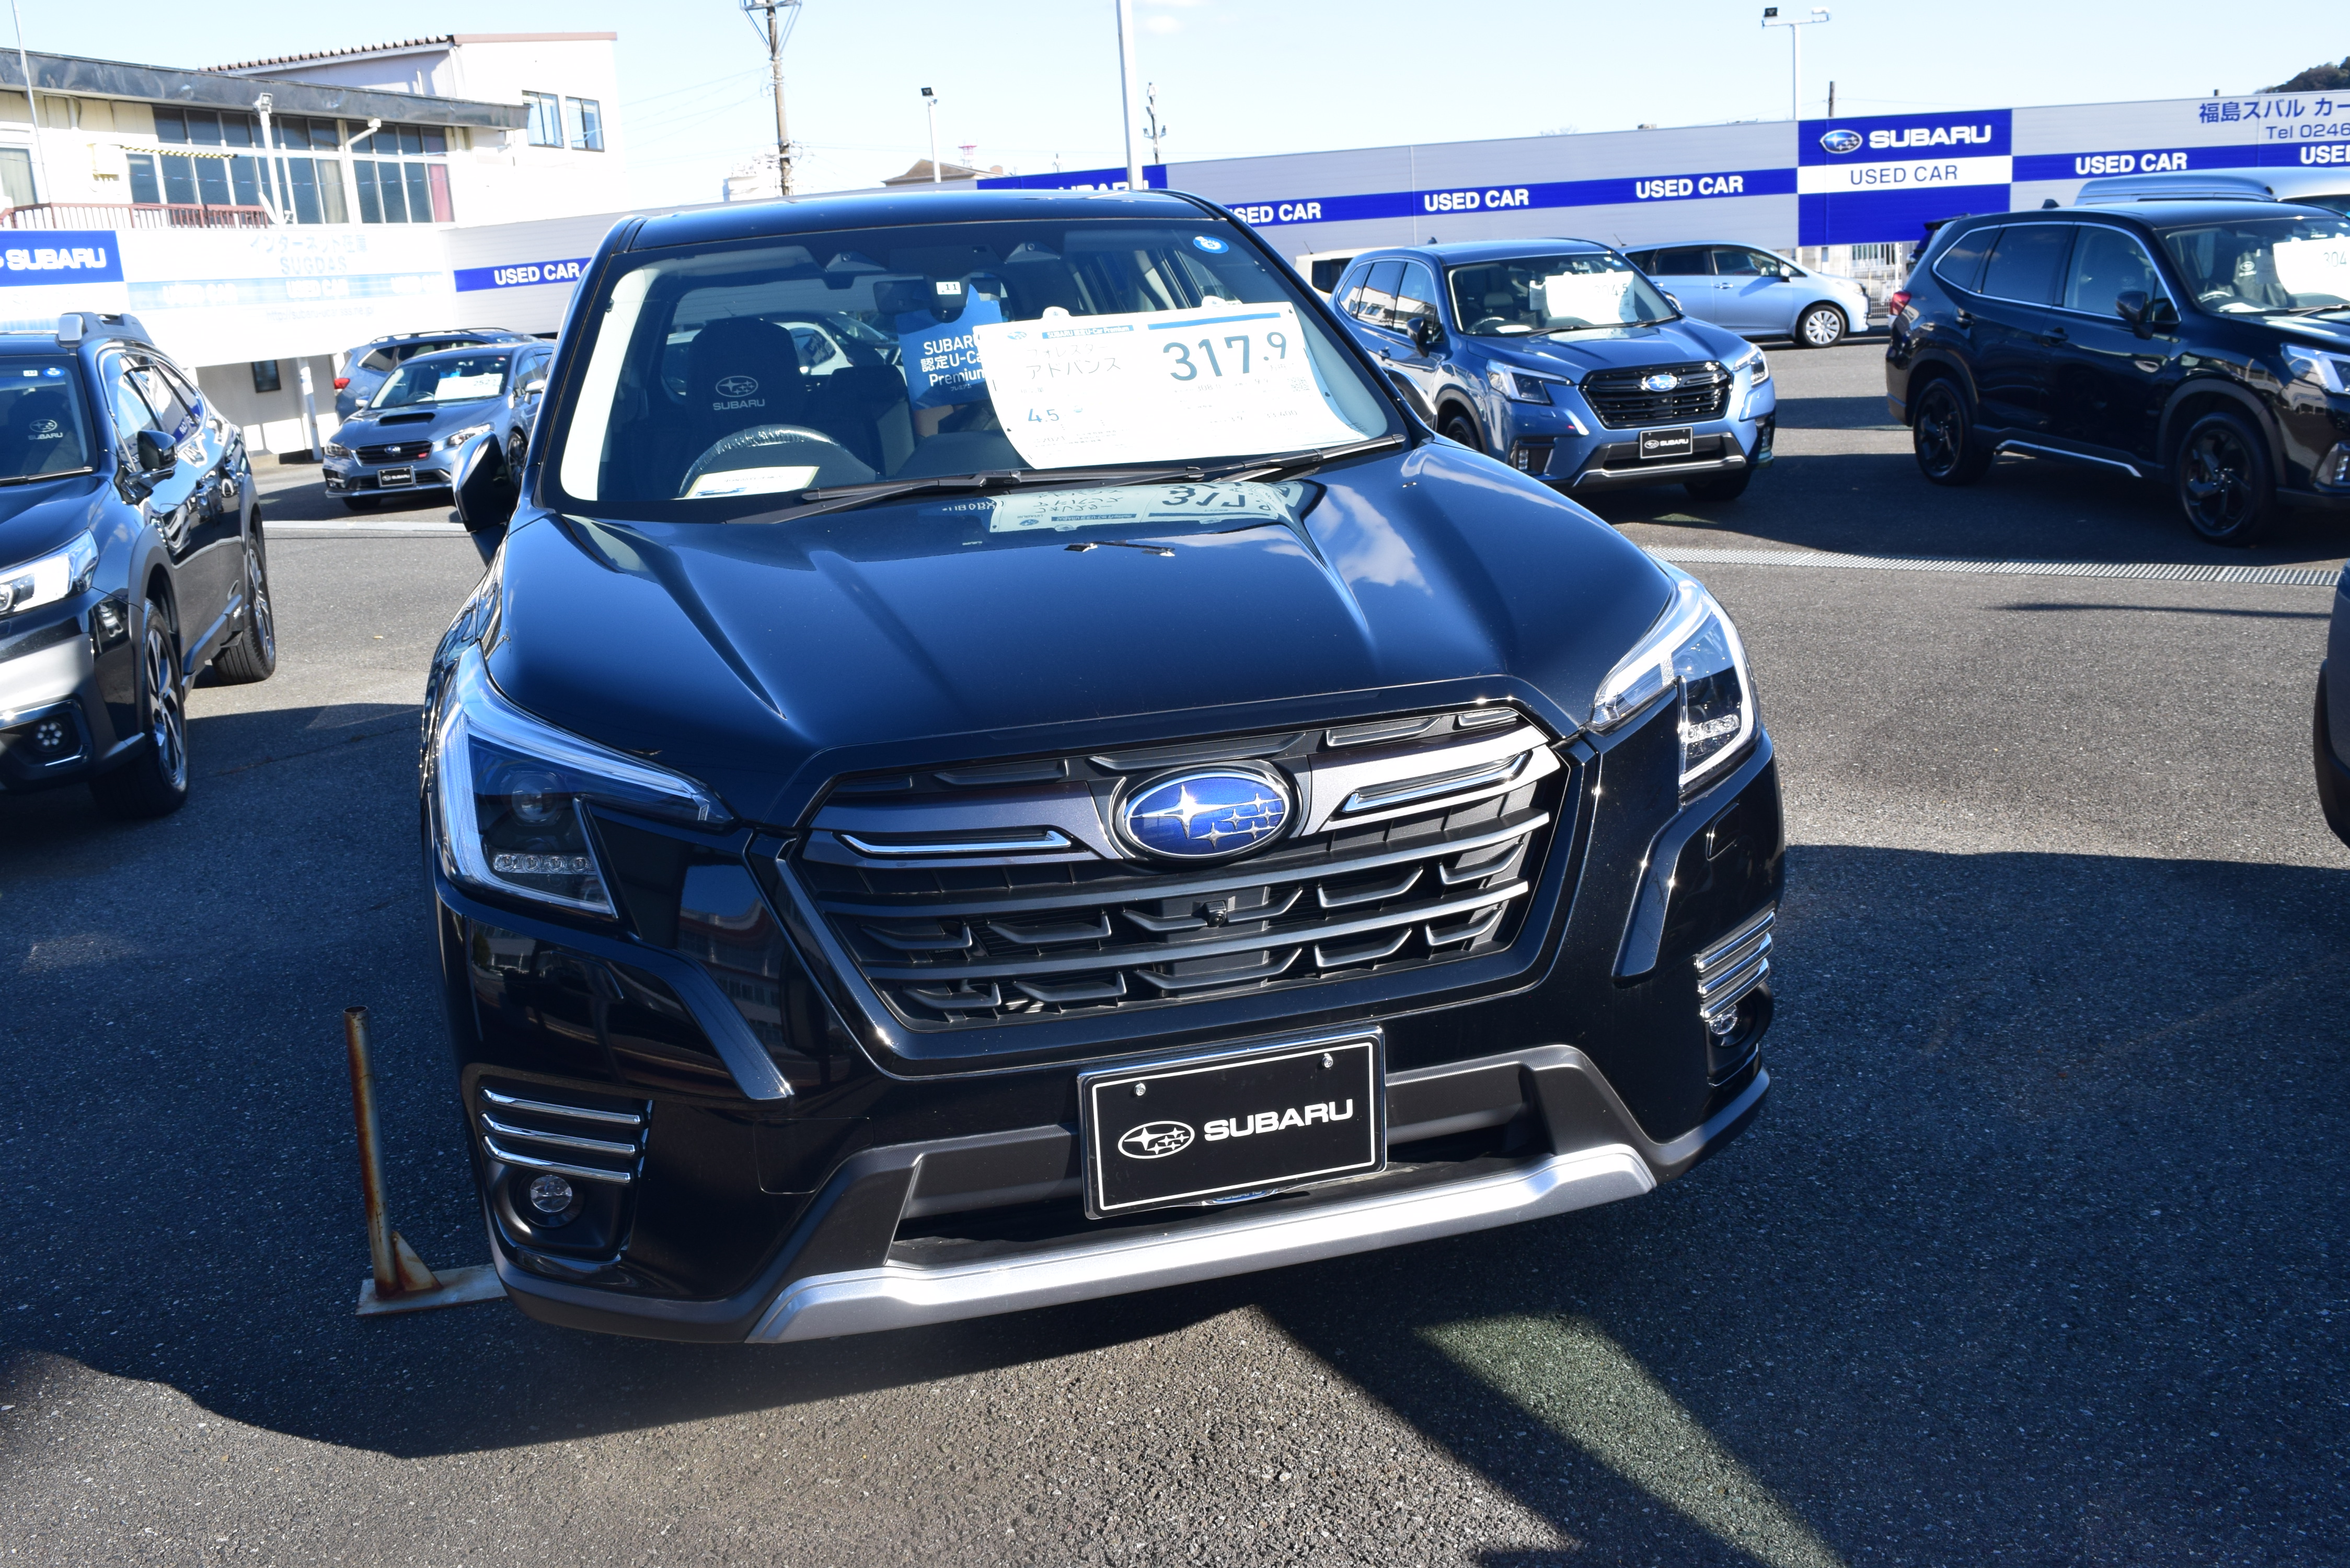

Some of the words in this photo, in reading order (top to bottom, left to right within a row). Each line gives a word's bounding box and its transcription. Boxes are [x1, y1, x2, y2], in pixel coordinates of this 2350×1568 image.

[2199, 98, 2305, 123] 福島スバル
[1869, 125, 1991, 149] SUBARU
[2266, 125, 2293, 140] Tel
[2300, 123, 2350, 138] 0246
[1850, 168, 1906, 185] USED
[1914, 165, 1958, 182] CAR
[2075, 155, 2135, 175] USED
[2140, 153, 2187, 171] CAR
[1635, 178, 1694, 199] USED
[1698, 176, 1744, 195] CAR
[1424, 192, 1480, 211] USED
[1484, 188, 1529, 207] CAR
[1229, 205, 1274, 223] SED
[1278, 202, 1321, 221] CAR
[6, 248, 106, 270] SUBARU
[494, 267, 540, 285] USED
[544, 262, 580, 280] CAR
[920, 350, 982, 373] 認定U-Ca
[1026, 358, 1121, 379] アドバンス
[713, 399, 765, 410] SUBARU
[1028, 408, 1060, 422] 4.5
[28, 432, 63, 440] SUBARU
[1204, 1099, 1354, 1142] SUBARU
